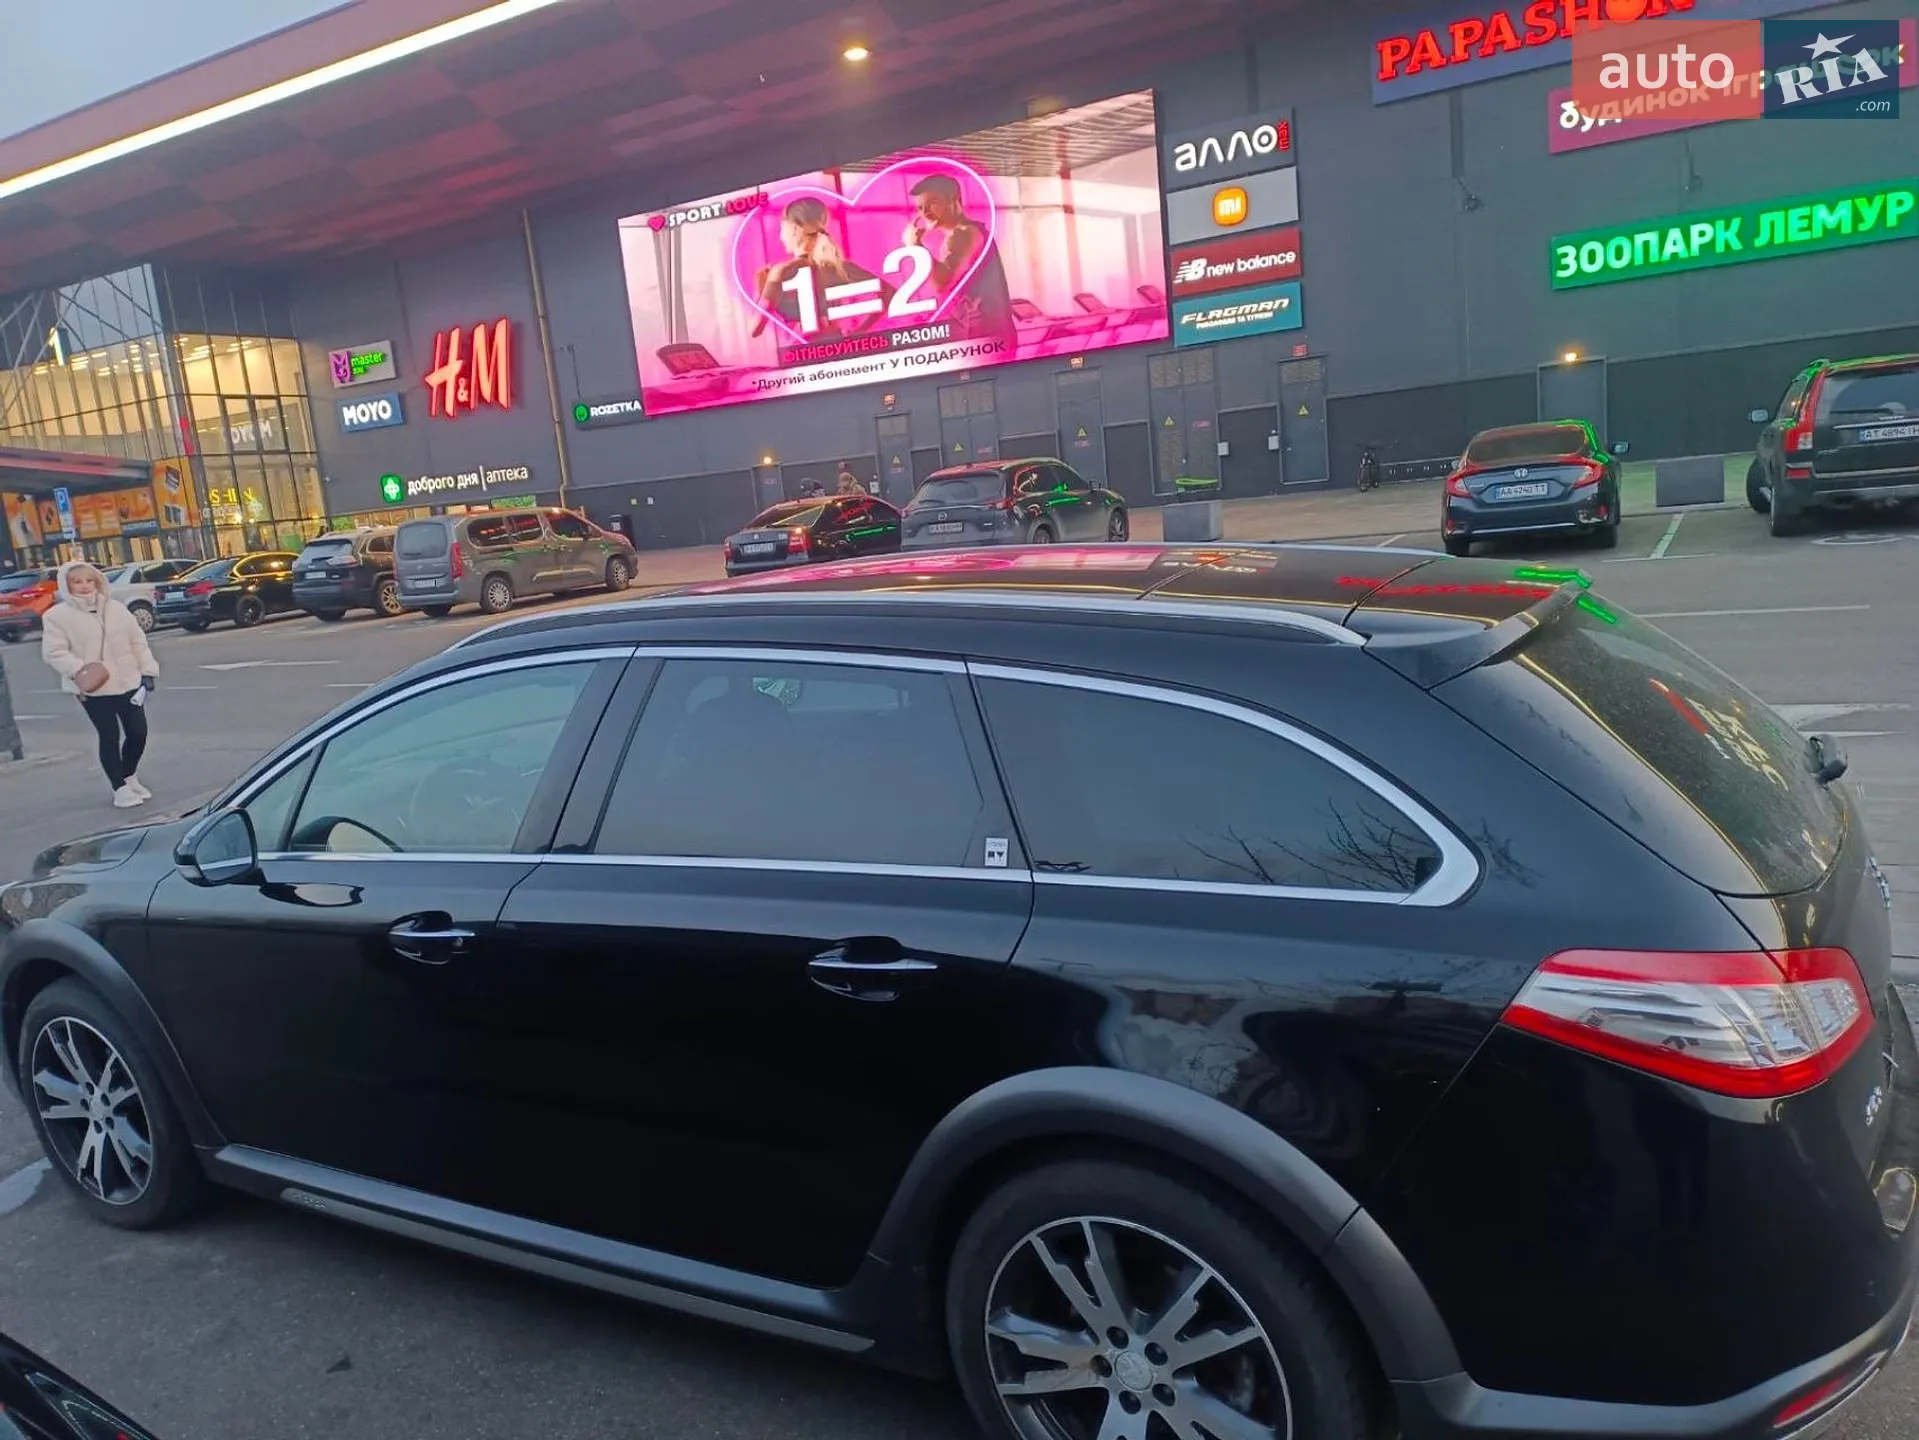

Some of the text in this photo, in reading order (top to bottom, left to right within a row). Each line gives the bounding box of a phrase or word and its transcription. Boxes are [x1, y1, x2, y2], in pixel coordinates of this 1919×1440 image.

[669, 203, 722, 228] SPORT
[1556, 191, 1914, 278] ЗООПАРК ЛЕМУР
[1207, 262, 1235, 278] new
[1237, 251, 1296, 272] balance
[781, 245, 938, 334] 1=2
[892, 324, 951, 346] РАЗОМ!
[424, 316, 511, 418] H&M
[809, 361, 886, 382] абонемент
[890, 357, 900, 369] У
[904, 340, 1007, 367] ПОДАРУНОК
[343, 400, 392, 426] MOYO
[590, 399, 642, 417] ROZETKA
[407, 466, 529, 496] доброго дня аптека
